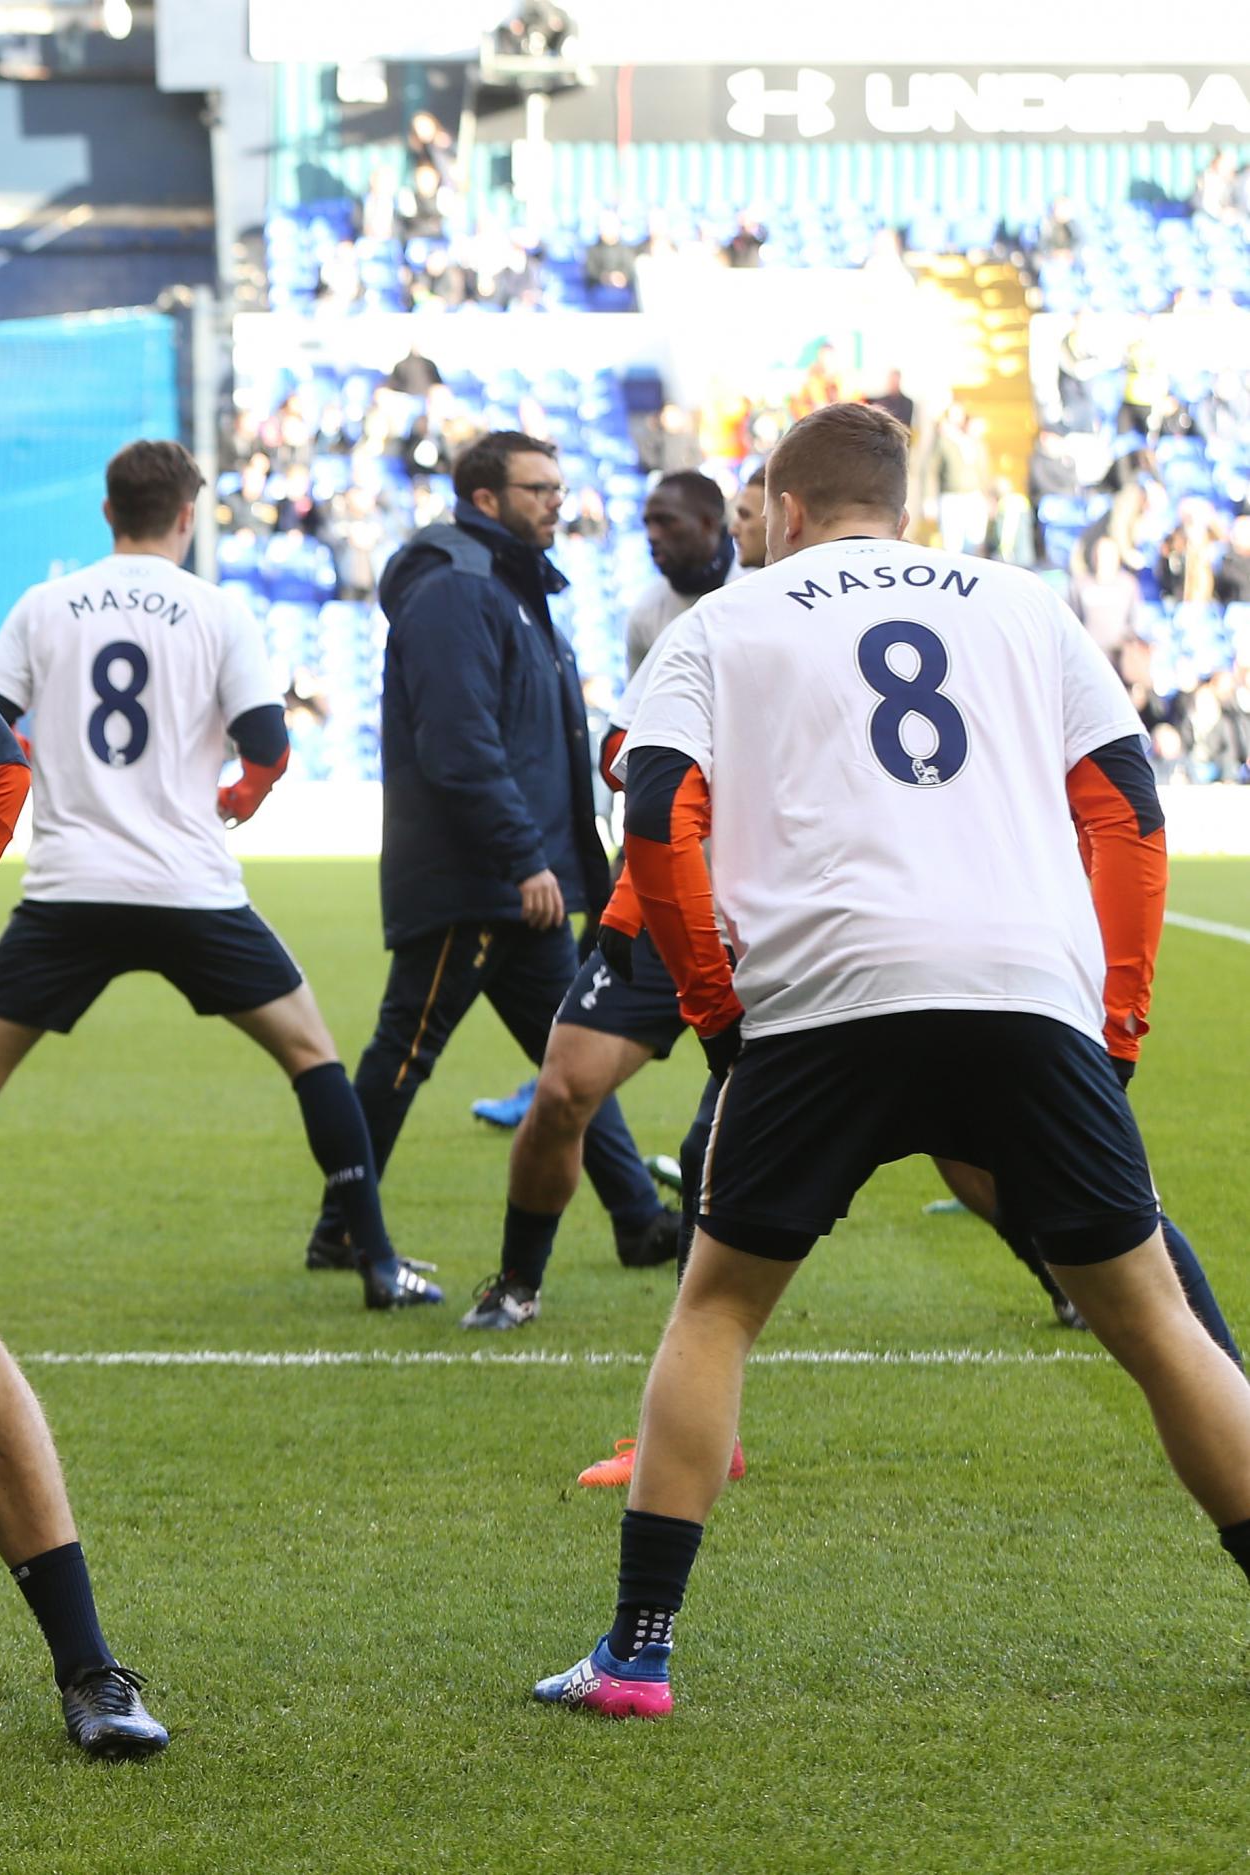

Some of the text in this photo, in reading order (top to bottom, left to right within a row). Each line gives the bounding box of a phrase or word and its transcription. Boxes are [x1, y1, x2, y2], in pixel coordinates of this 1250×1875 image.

[69, 589, 188, 627] MASON
[786, 565, 979, 610] MASON
[88, 639, 149, 767] 8
[854, 617, 971, 788] 8
[561, 1678, 601, 1704] adidas
